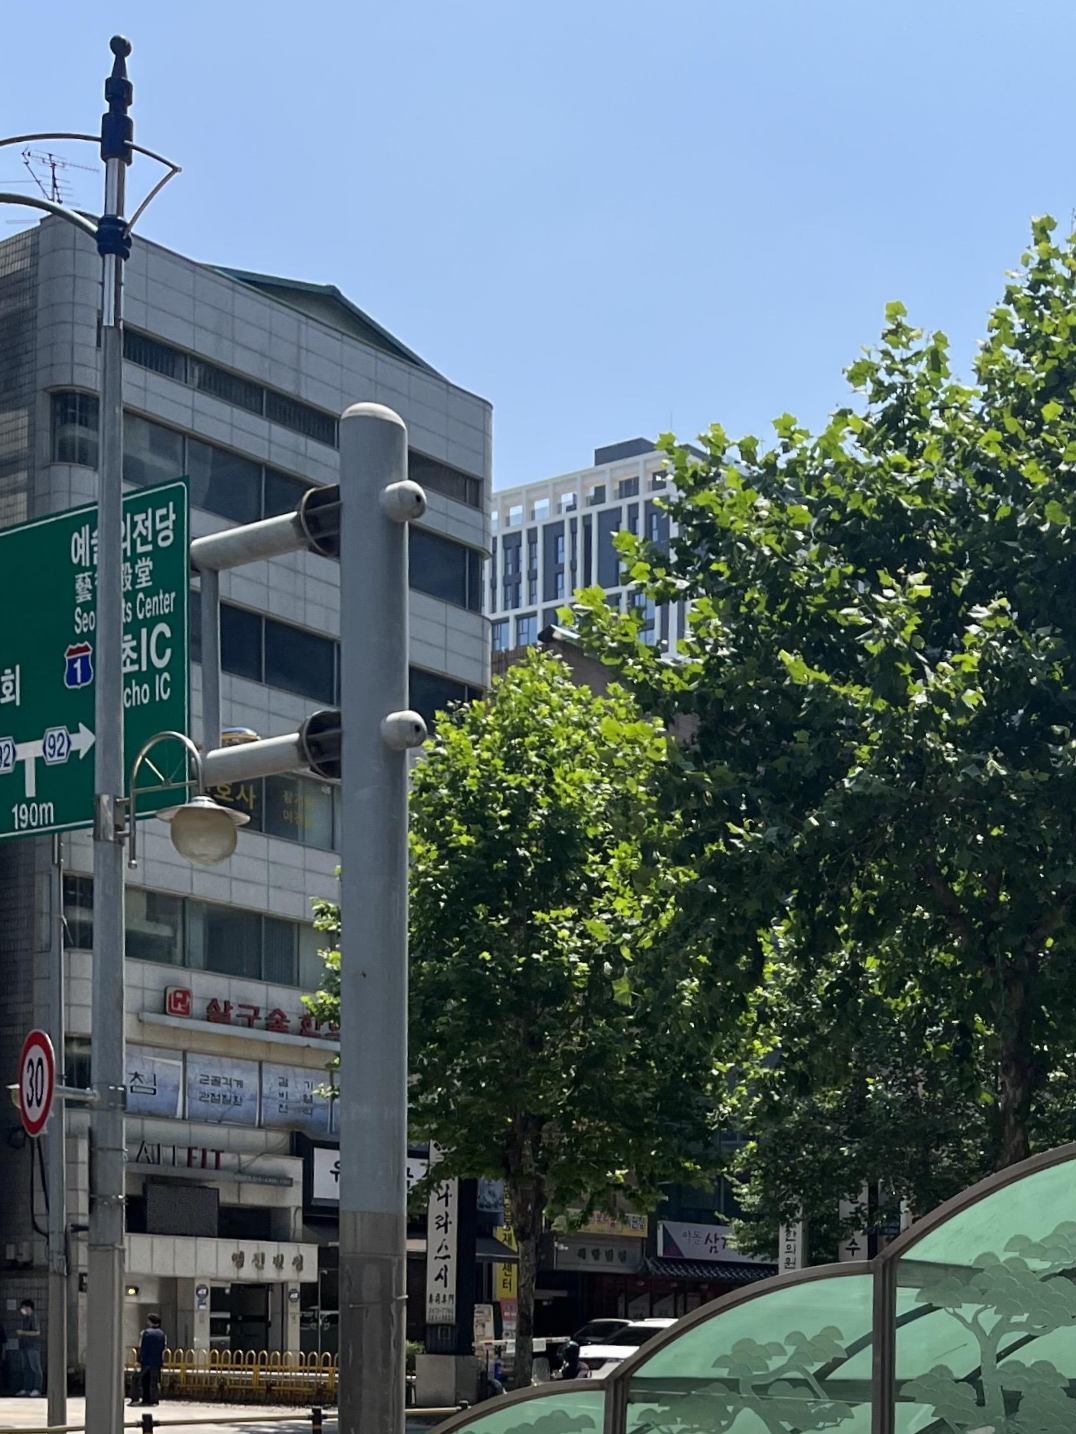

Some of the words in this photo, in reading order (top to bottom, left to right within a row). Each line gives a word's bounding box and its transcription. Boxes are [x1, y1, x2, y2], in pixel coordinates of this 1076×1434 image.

[137, 589, 176, 620] Center
[122, 622, 172, 674] 초IC
[73, 658, 82, 683] 1
[155, 672, 171, 701] IC
[49, 732, 65, 759] 92
[12, 802, 54, 830] 190m
[26, 1056, 44, 1109] 30
